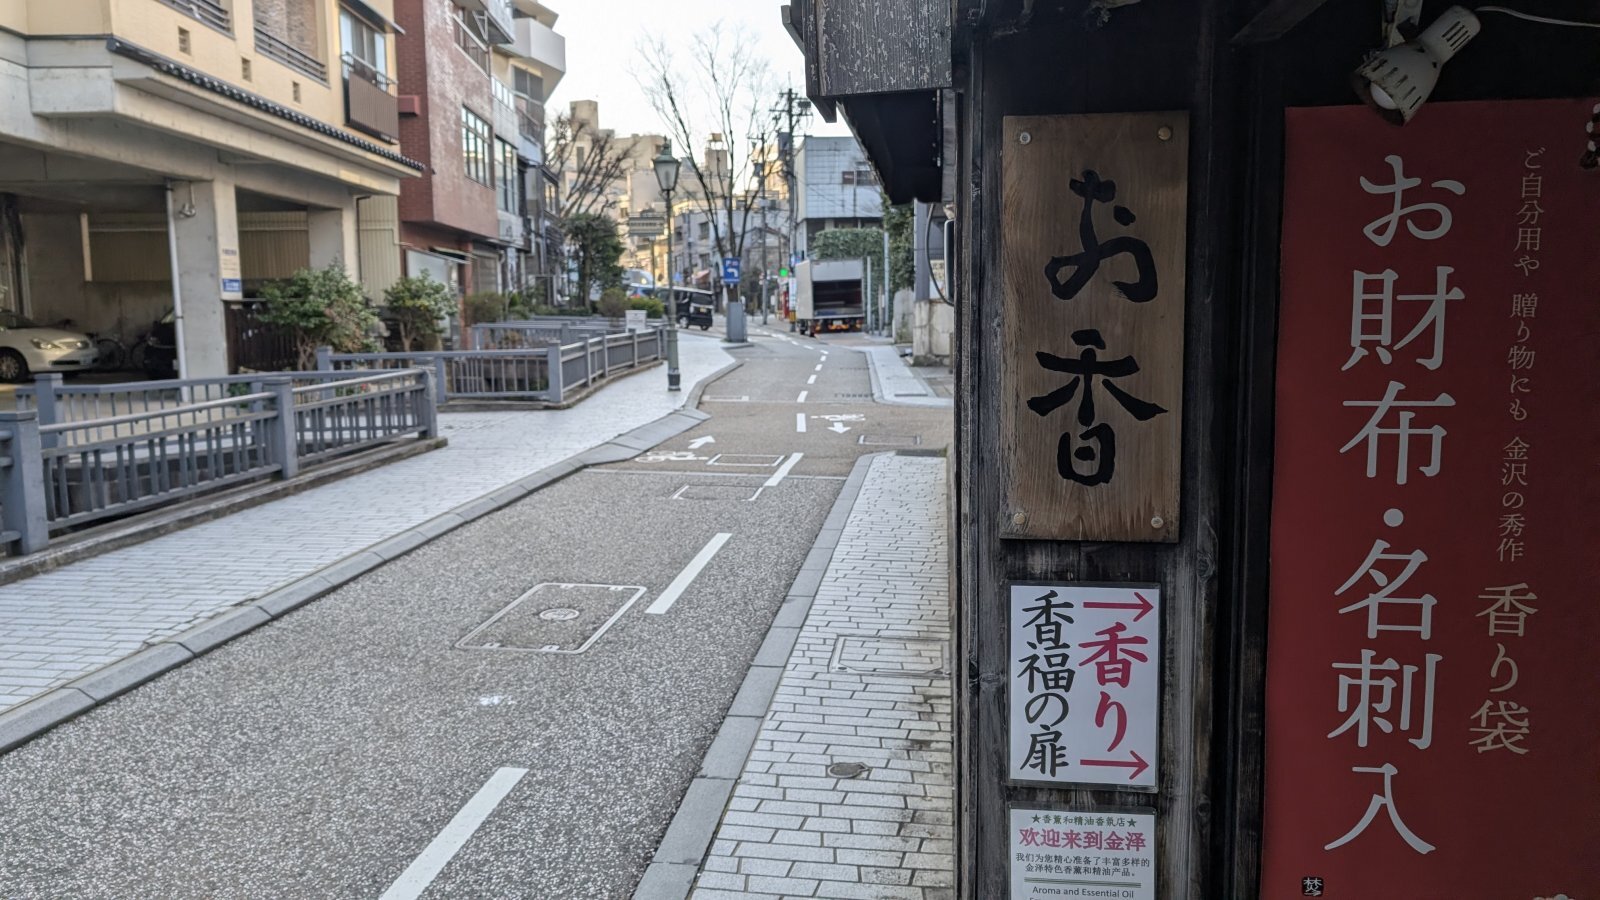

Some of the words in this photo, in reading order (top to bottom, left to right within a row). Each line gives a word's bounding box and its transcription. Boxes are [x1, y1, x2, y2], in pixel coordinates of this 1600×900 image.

[1513, 147, 1546, 277] ご自分用や
[1026, 168, 1169, 487] お香
[1507, 292, 1539, 421] 贈り物にも
[1324, 154, 1467, 855] お財布・名刺入
[1497, 436, 1531, 562] 金沢の秀作
[1017, 589, 1076, 778] 香福の扉
[1078, 621, 1149, 753] 香り
[1468, 582, 1539, 755] 香り袋
[1016, 853, 1150, 867] 我们为您精心准备了丰富多样的
[1019, 827, 1146, 852] 欢迎来到金泽
[1032, 886, 1061, 895] Aroma
[1063, 887, 1080, 896] and
[1081, 888, 1119, 898] Essential
[1122, 890, 1134, 898] Oil
